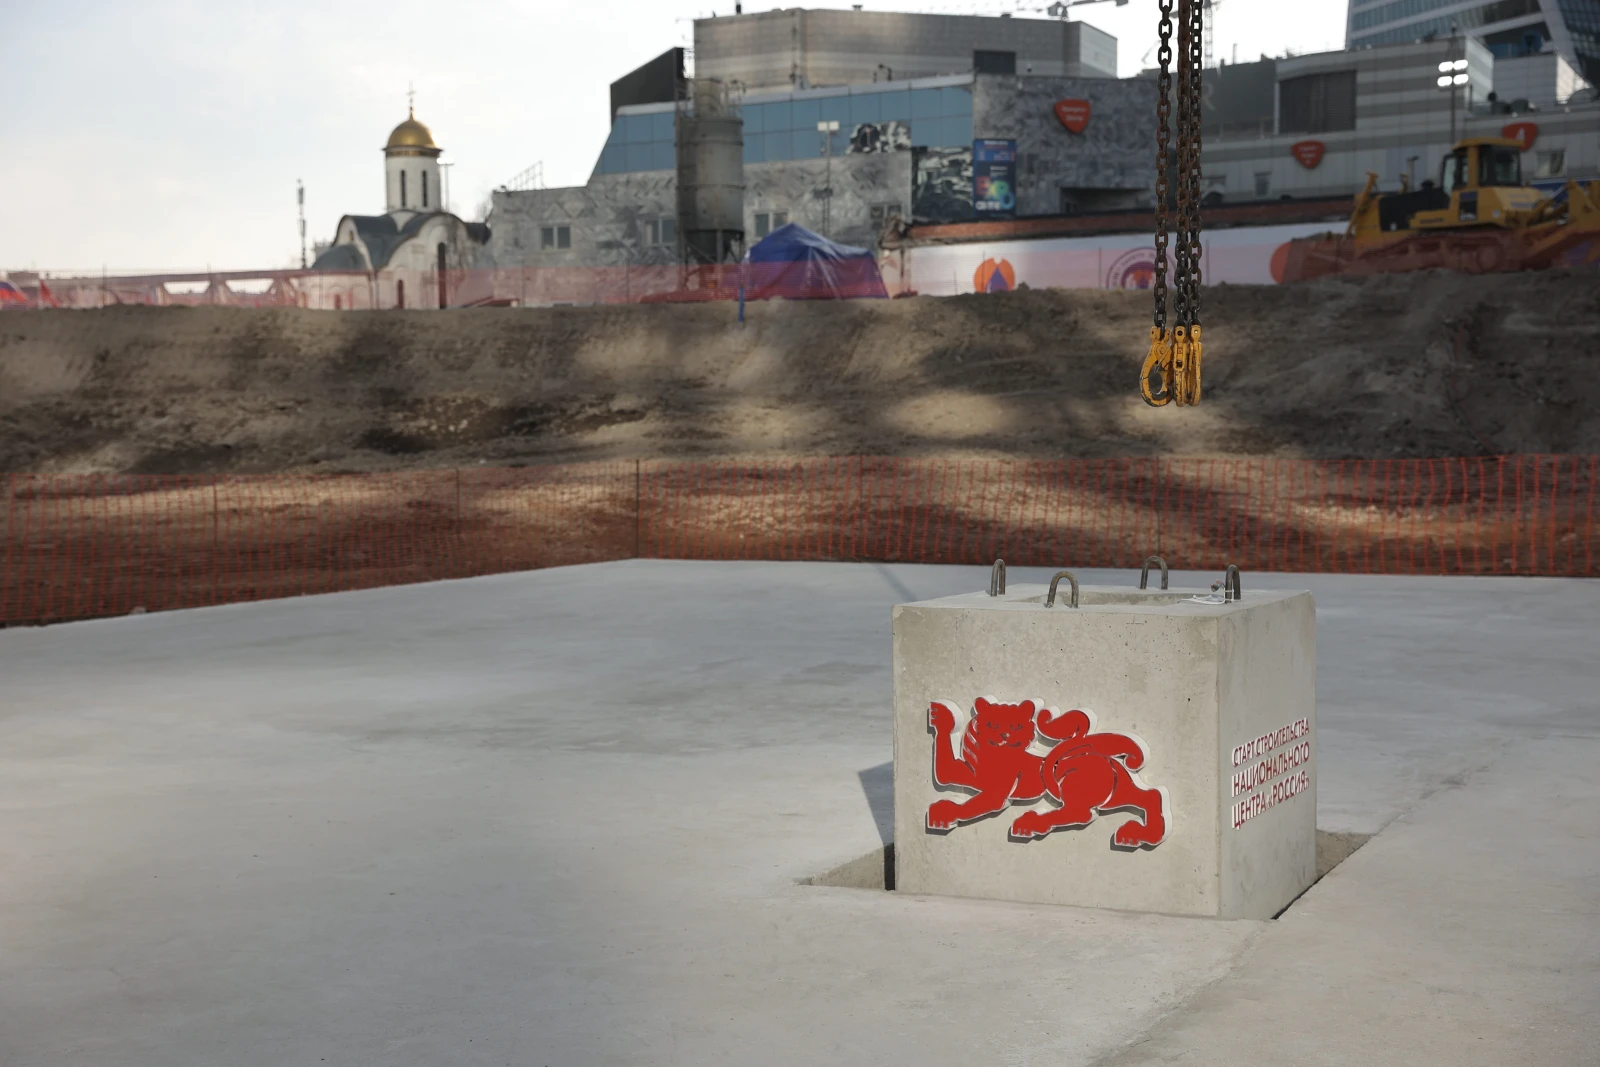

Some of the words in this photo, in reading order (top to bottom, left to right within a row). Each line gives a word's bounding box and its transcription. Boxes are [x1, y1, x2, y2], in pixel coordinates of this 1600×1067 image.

[1232, 740, 1255, 767] СТАРТ
[1255, 717, 1310, 758] СТРОИТЕЛЬСТВА
[1232, 741, 1310, 797] НАЦИОНАЛЬНОГО
[1232, 791, 1267, 830] ЦЕНТРА
[1267, 770, 1310, 810] «РОССИЯ»
